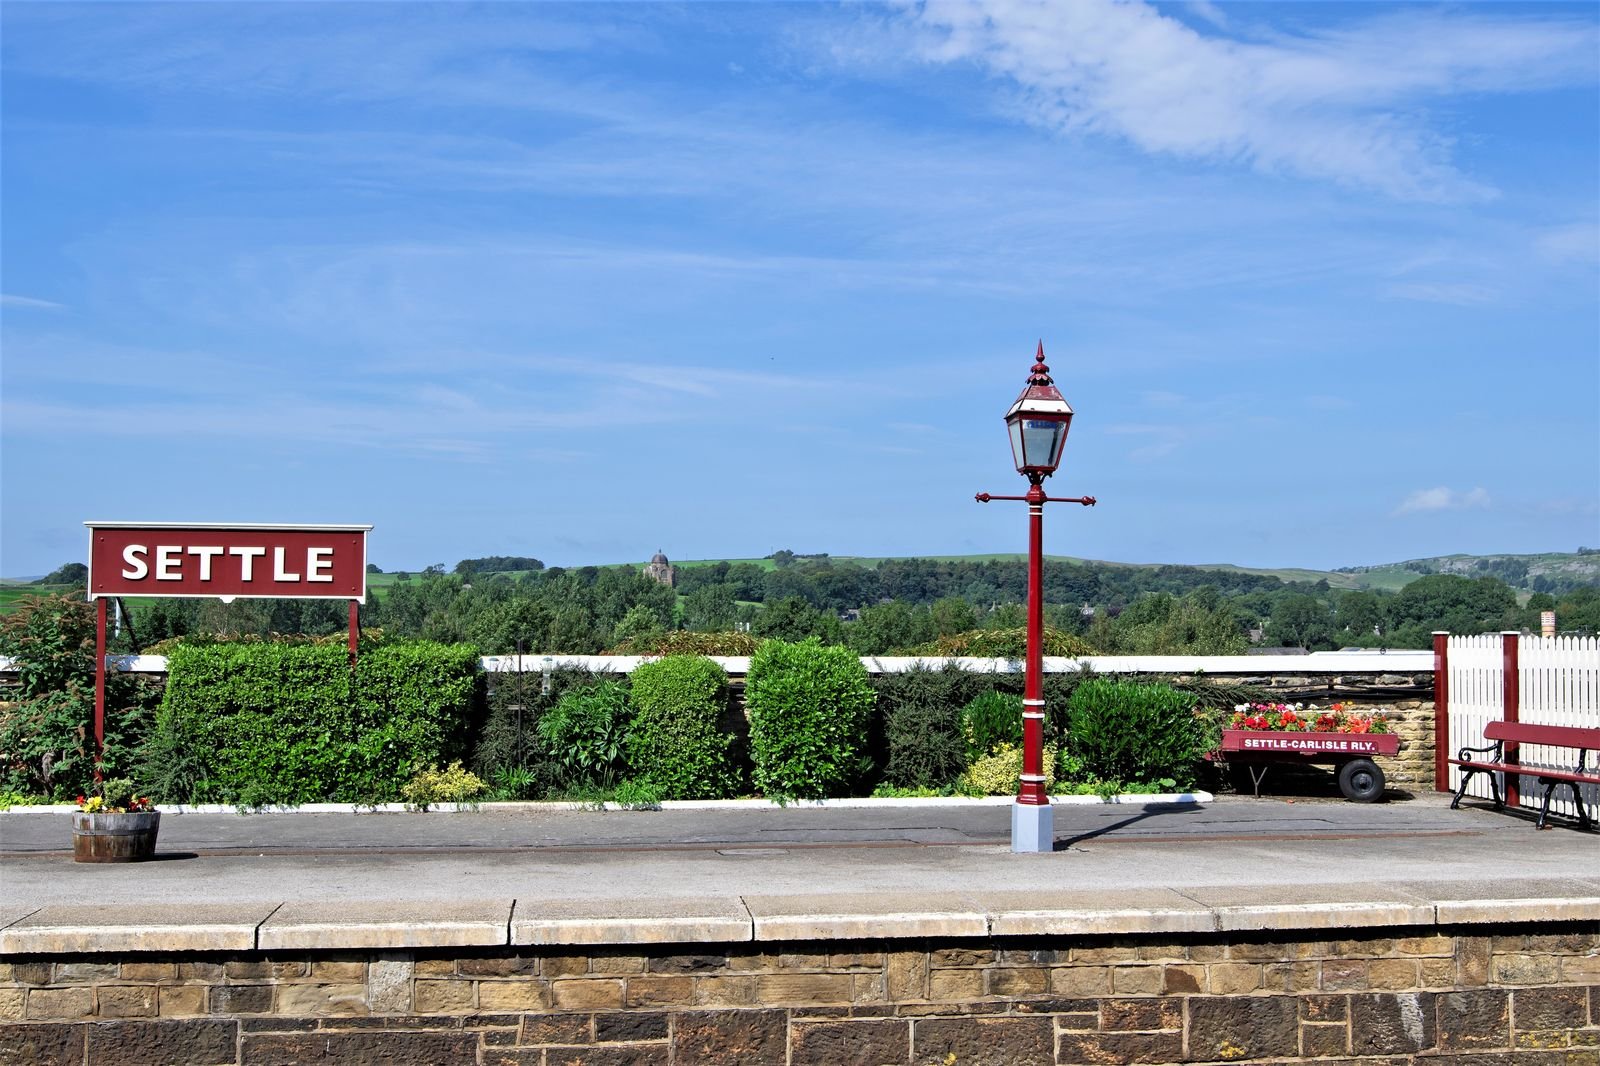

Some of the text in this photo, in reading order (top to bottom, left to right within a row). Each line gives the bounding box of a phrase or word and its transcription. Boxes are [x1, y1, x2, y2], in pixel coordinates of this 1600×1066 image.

[122, 544, 334, 582] SETTLE
[1244, 739, 1376, 751] SETTLE-CARLISLE RLY.
